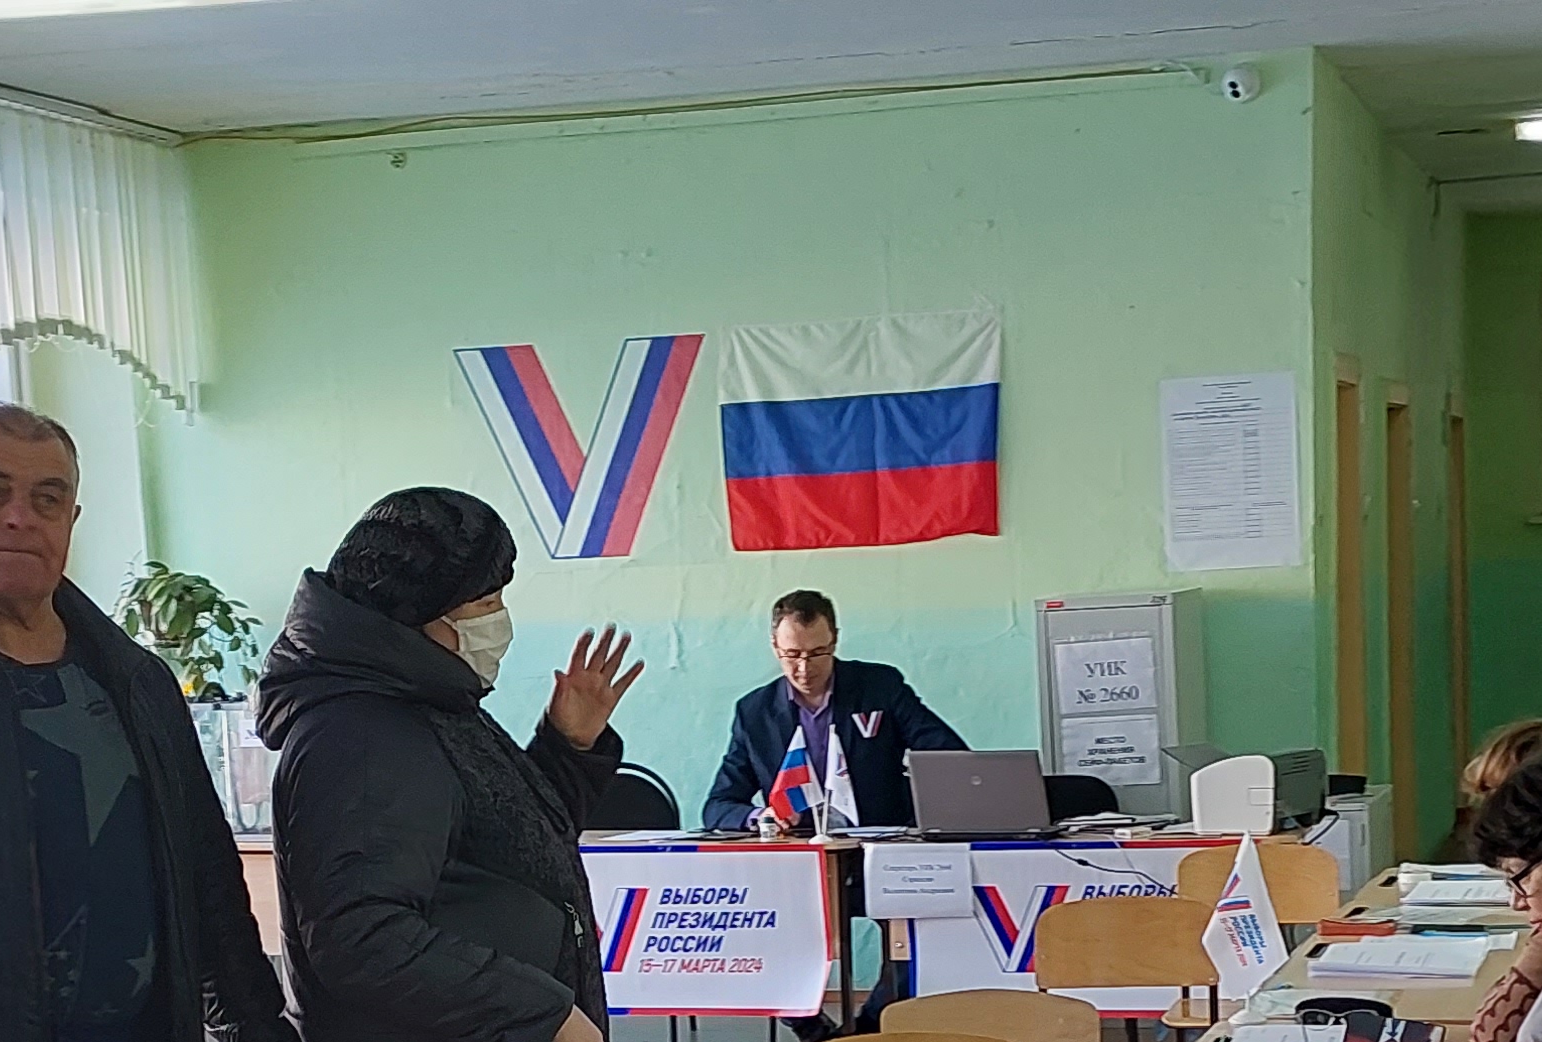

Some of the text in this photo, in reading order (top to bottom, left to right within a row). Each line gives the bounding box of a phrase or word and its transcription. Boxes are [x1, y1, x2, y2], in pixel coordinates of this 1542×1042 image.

[1084, 660, 1128, 678] УИК
[1076, 685, 1140, 704] № 2660
[658, 888, 749, 905] ВЫБОРЫ
[650, 911, 778, 931] ПРЕЗИДЕНТА
[643, 936, 725, 953] РОССИИ
[678, 958, 726, 973] МАРТА
[728, 958, 763, 973] 2024
